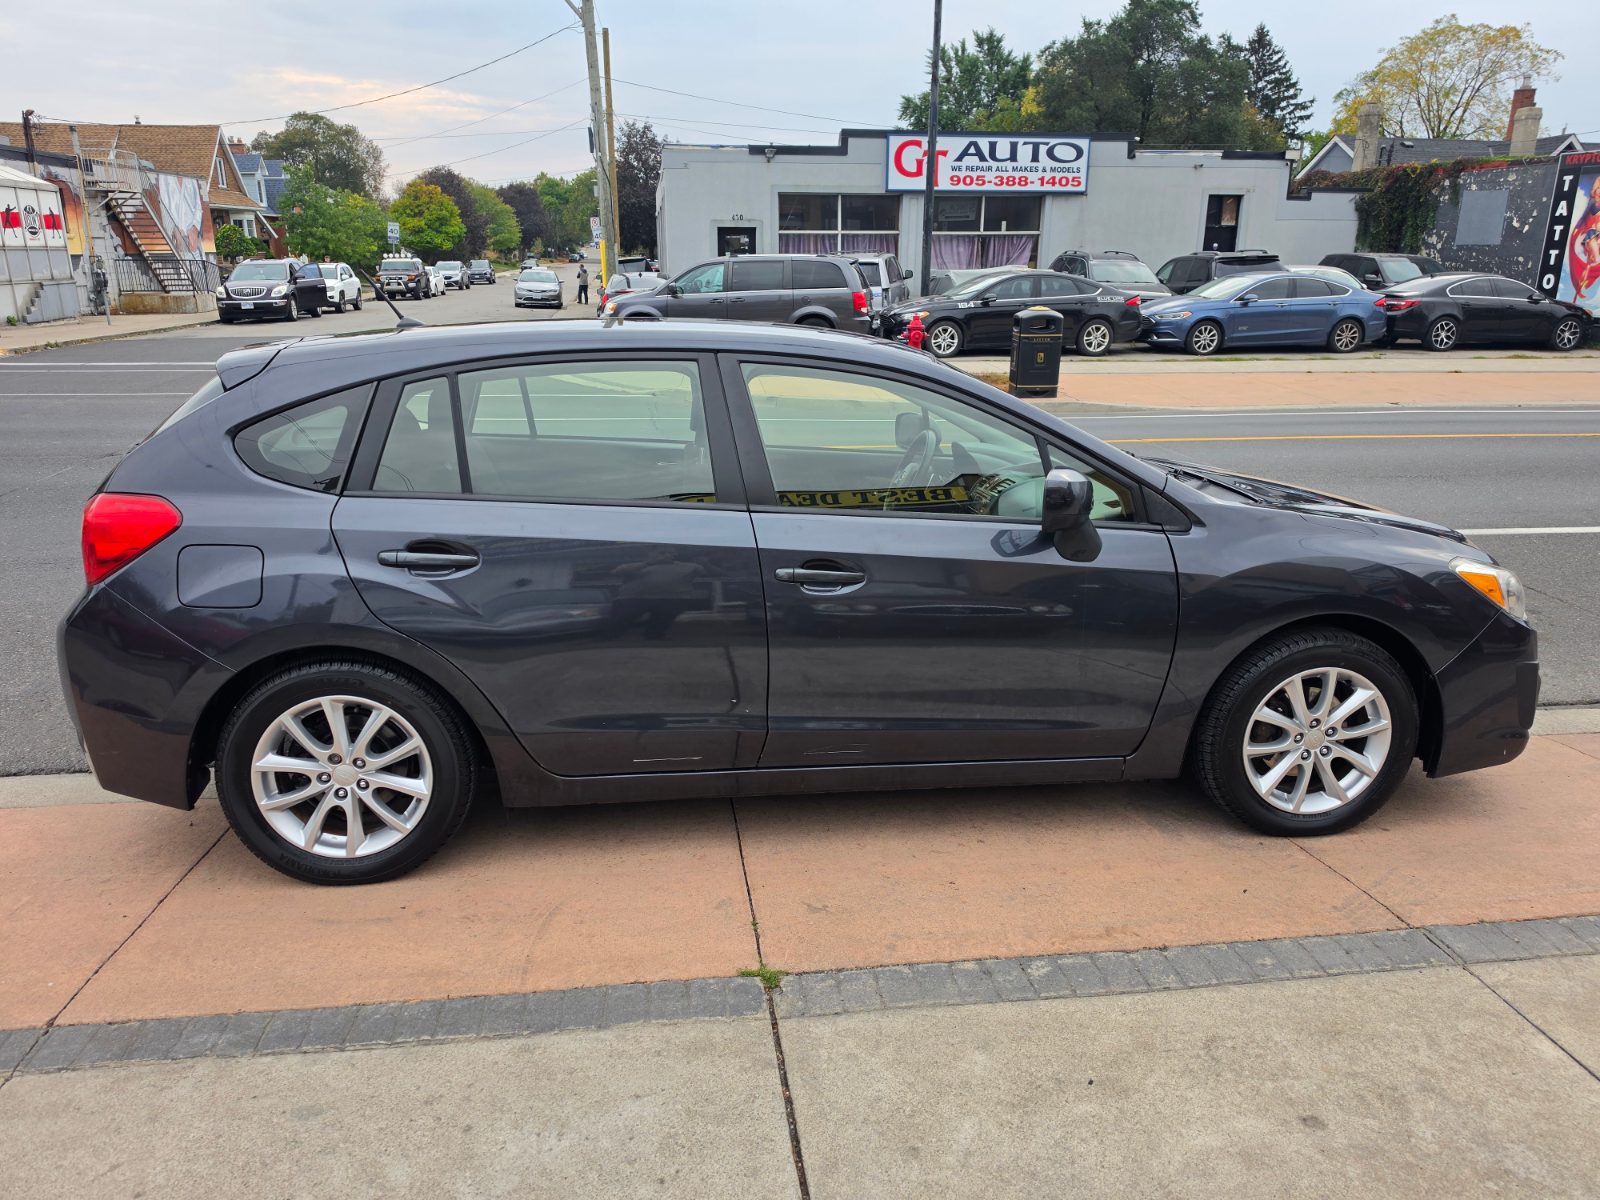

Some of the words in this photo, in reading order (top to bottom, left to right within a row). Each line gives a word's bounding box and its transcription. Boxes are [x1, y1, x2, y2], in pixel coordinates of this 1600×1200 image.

[894, 139, 948, 187] GT
[954, 140, 1084, 163] AUTO
[950, 175, 1082, 187] 905-388-1405
